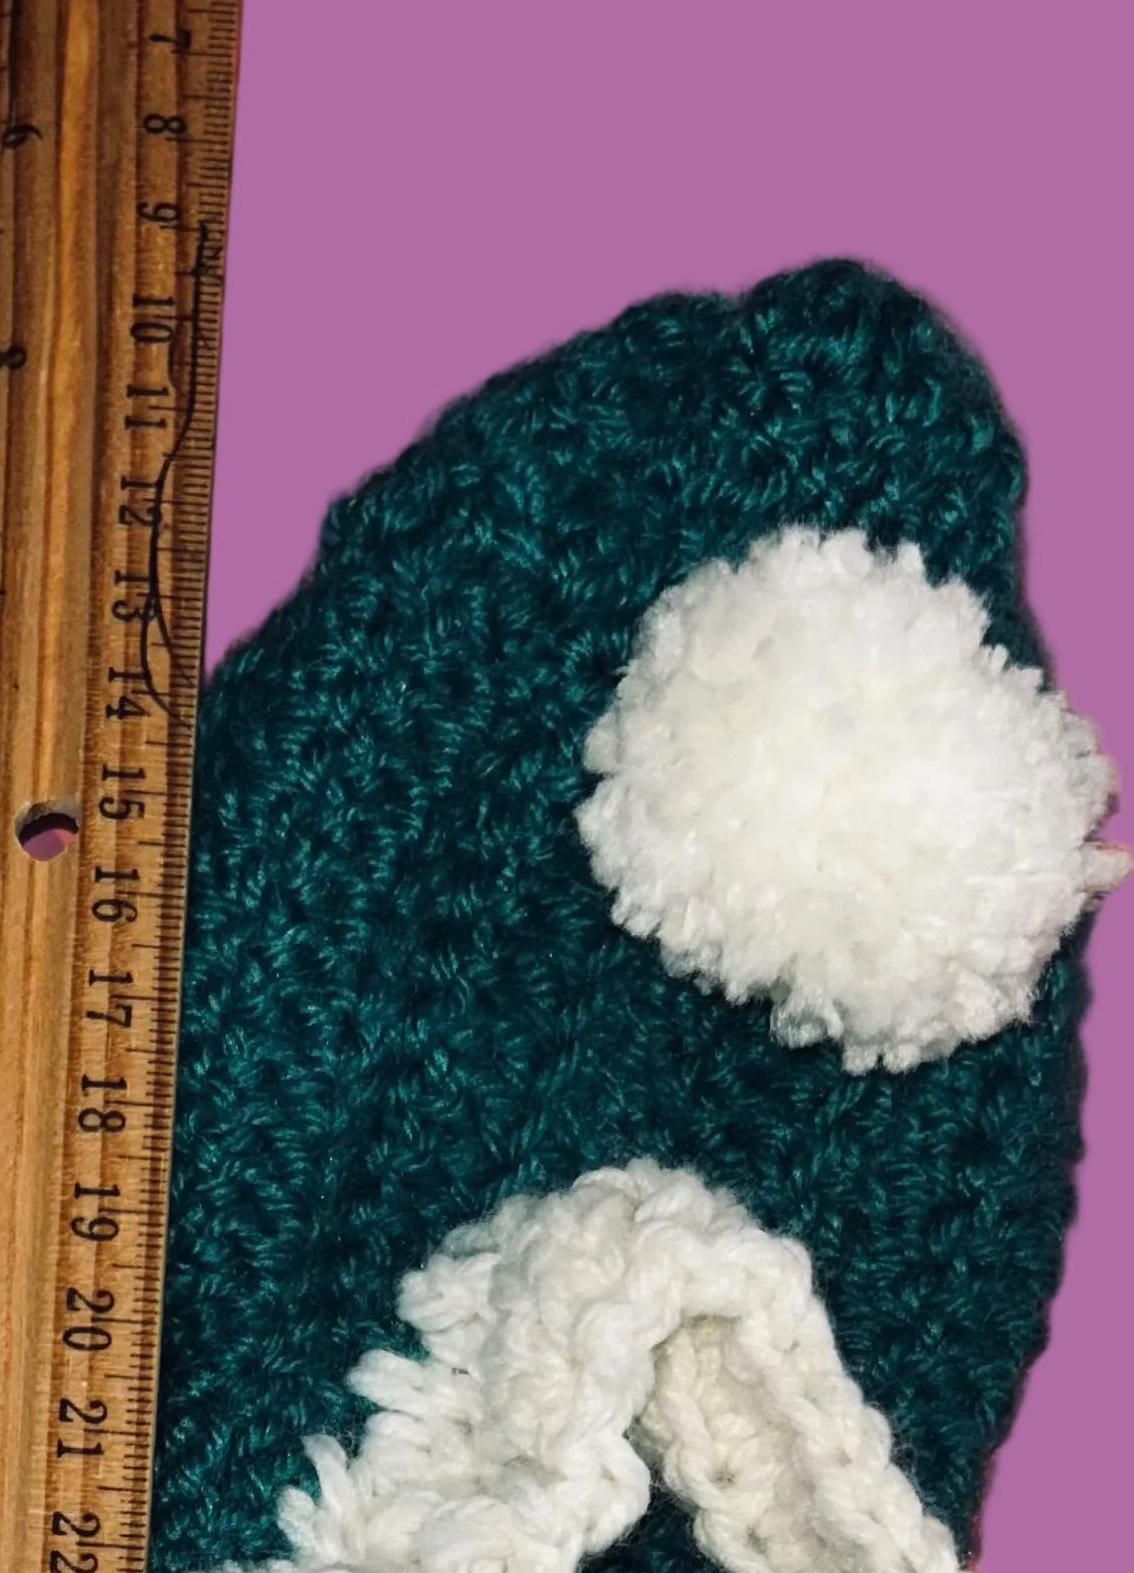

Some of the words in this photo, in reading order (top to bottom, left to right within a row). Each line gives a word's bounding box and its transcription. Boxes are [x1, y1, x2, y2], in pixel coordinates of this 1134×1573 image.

[150, 30, 191, 49] 7
[143, 113, 187, 135] 8
[136, 202, 179, 225] 9
[130, 297, 174, 344] 10
[124, 384, 169, 430] 11
[118, 476, 162, 525] 12
[111, 570, 156, 622] 13
[106, 667, 151, 719] 14
[99, 764, 146, 821] 15
[91, 865, 140, 923] 16
[85, 969, 134, 1028] 17
[77, 1074, 127, 1133] 18
[70, 1182, 121, 1242] 19
[62, 1286, 115, 1351] 20
[56, 1397, 108, 1459] 21
